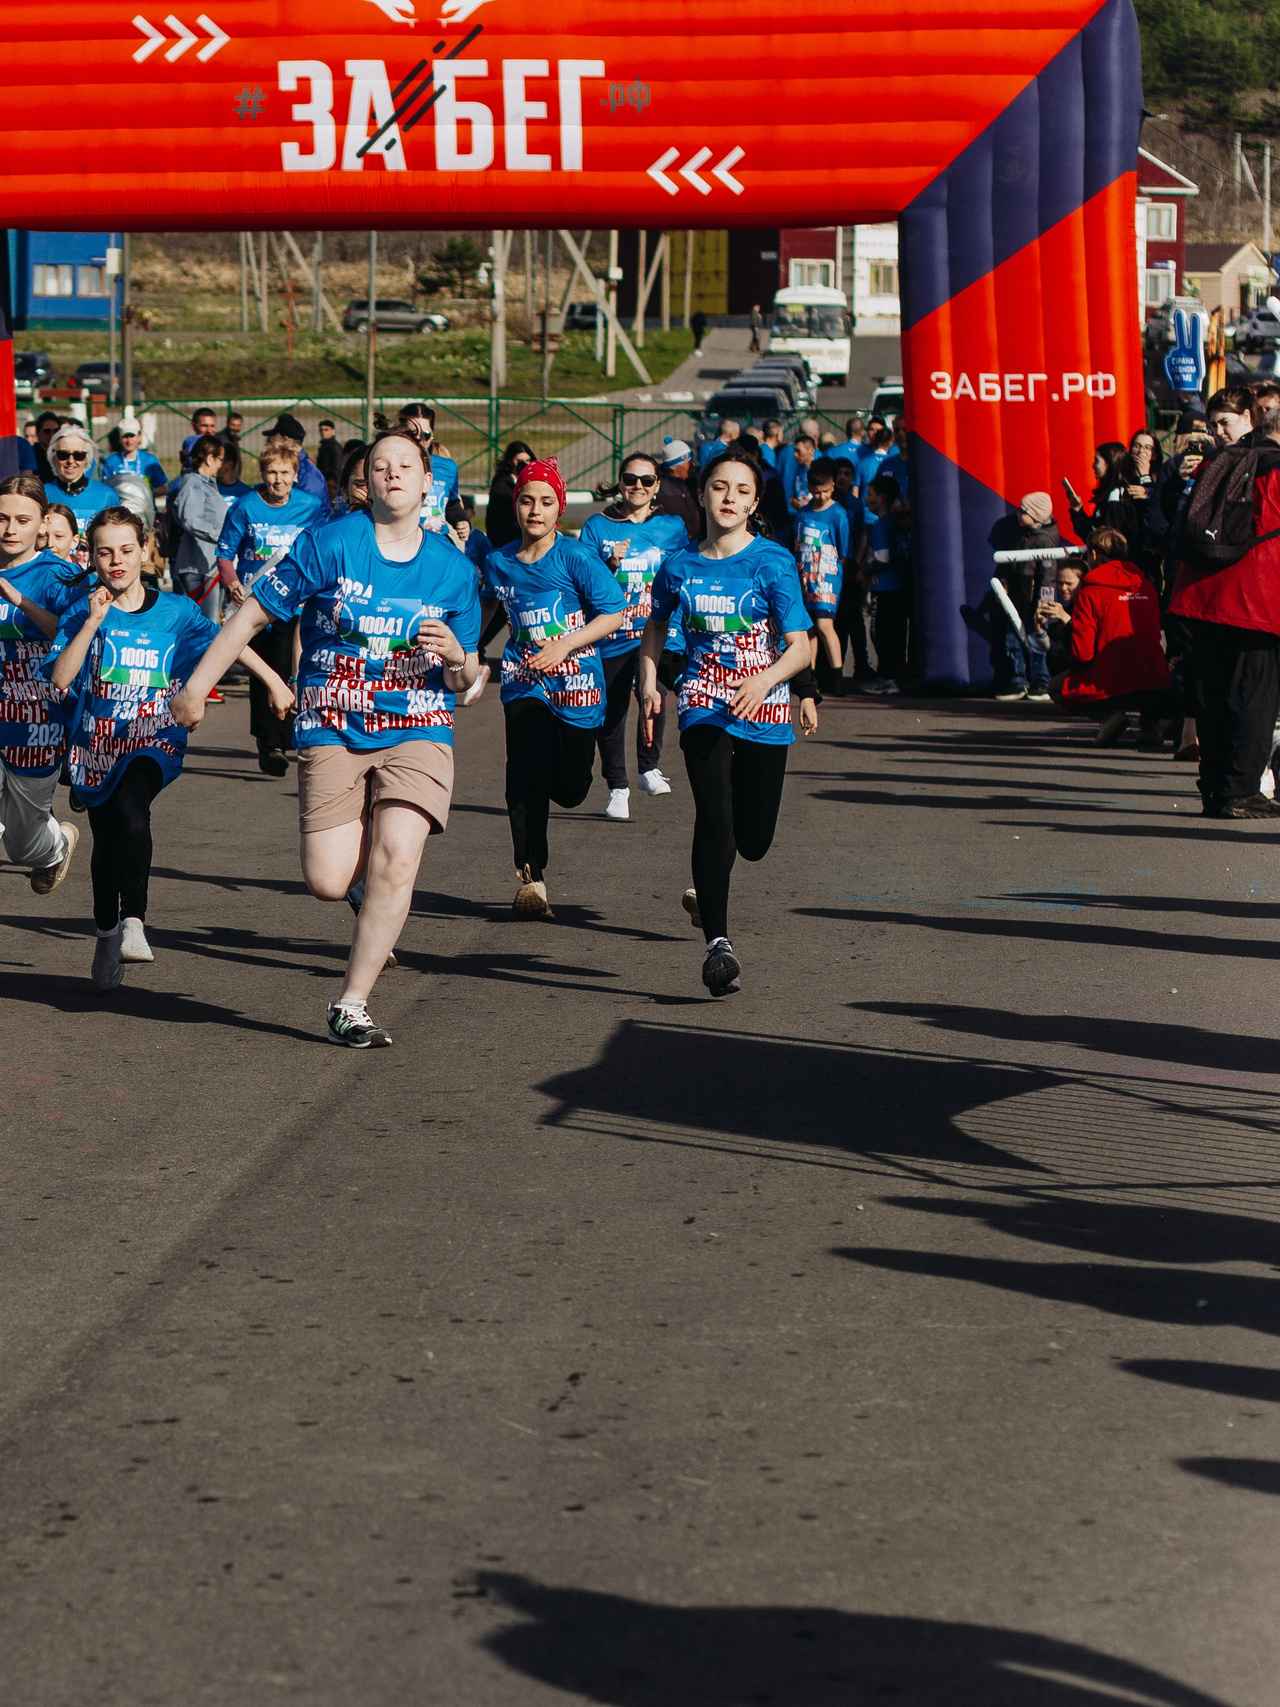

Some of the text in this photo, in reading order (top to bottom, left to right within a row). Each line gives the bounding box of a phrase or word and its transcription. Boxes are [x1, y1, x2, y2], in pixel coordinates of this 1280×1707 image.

[930, 371, 1116, 402] ЗАБЕГ.РФ
[270, 575, 290, 597] ПСБ
[694, 594, 736, 614] 10005
[358, 615, 403, 636] 10041
[519, 607, 551, 627] 10075
[120, 647, 159, 669] 10015
[565, 673, 595, 691] 2024
[406, 690, 446, 714] 2024
